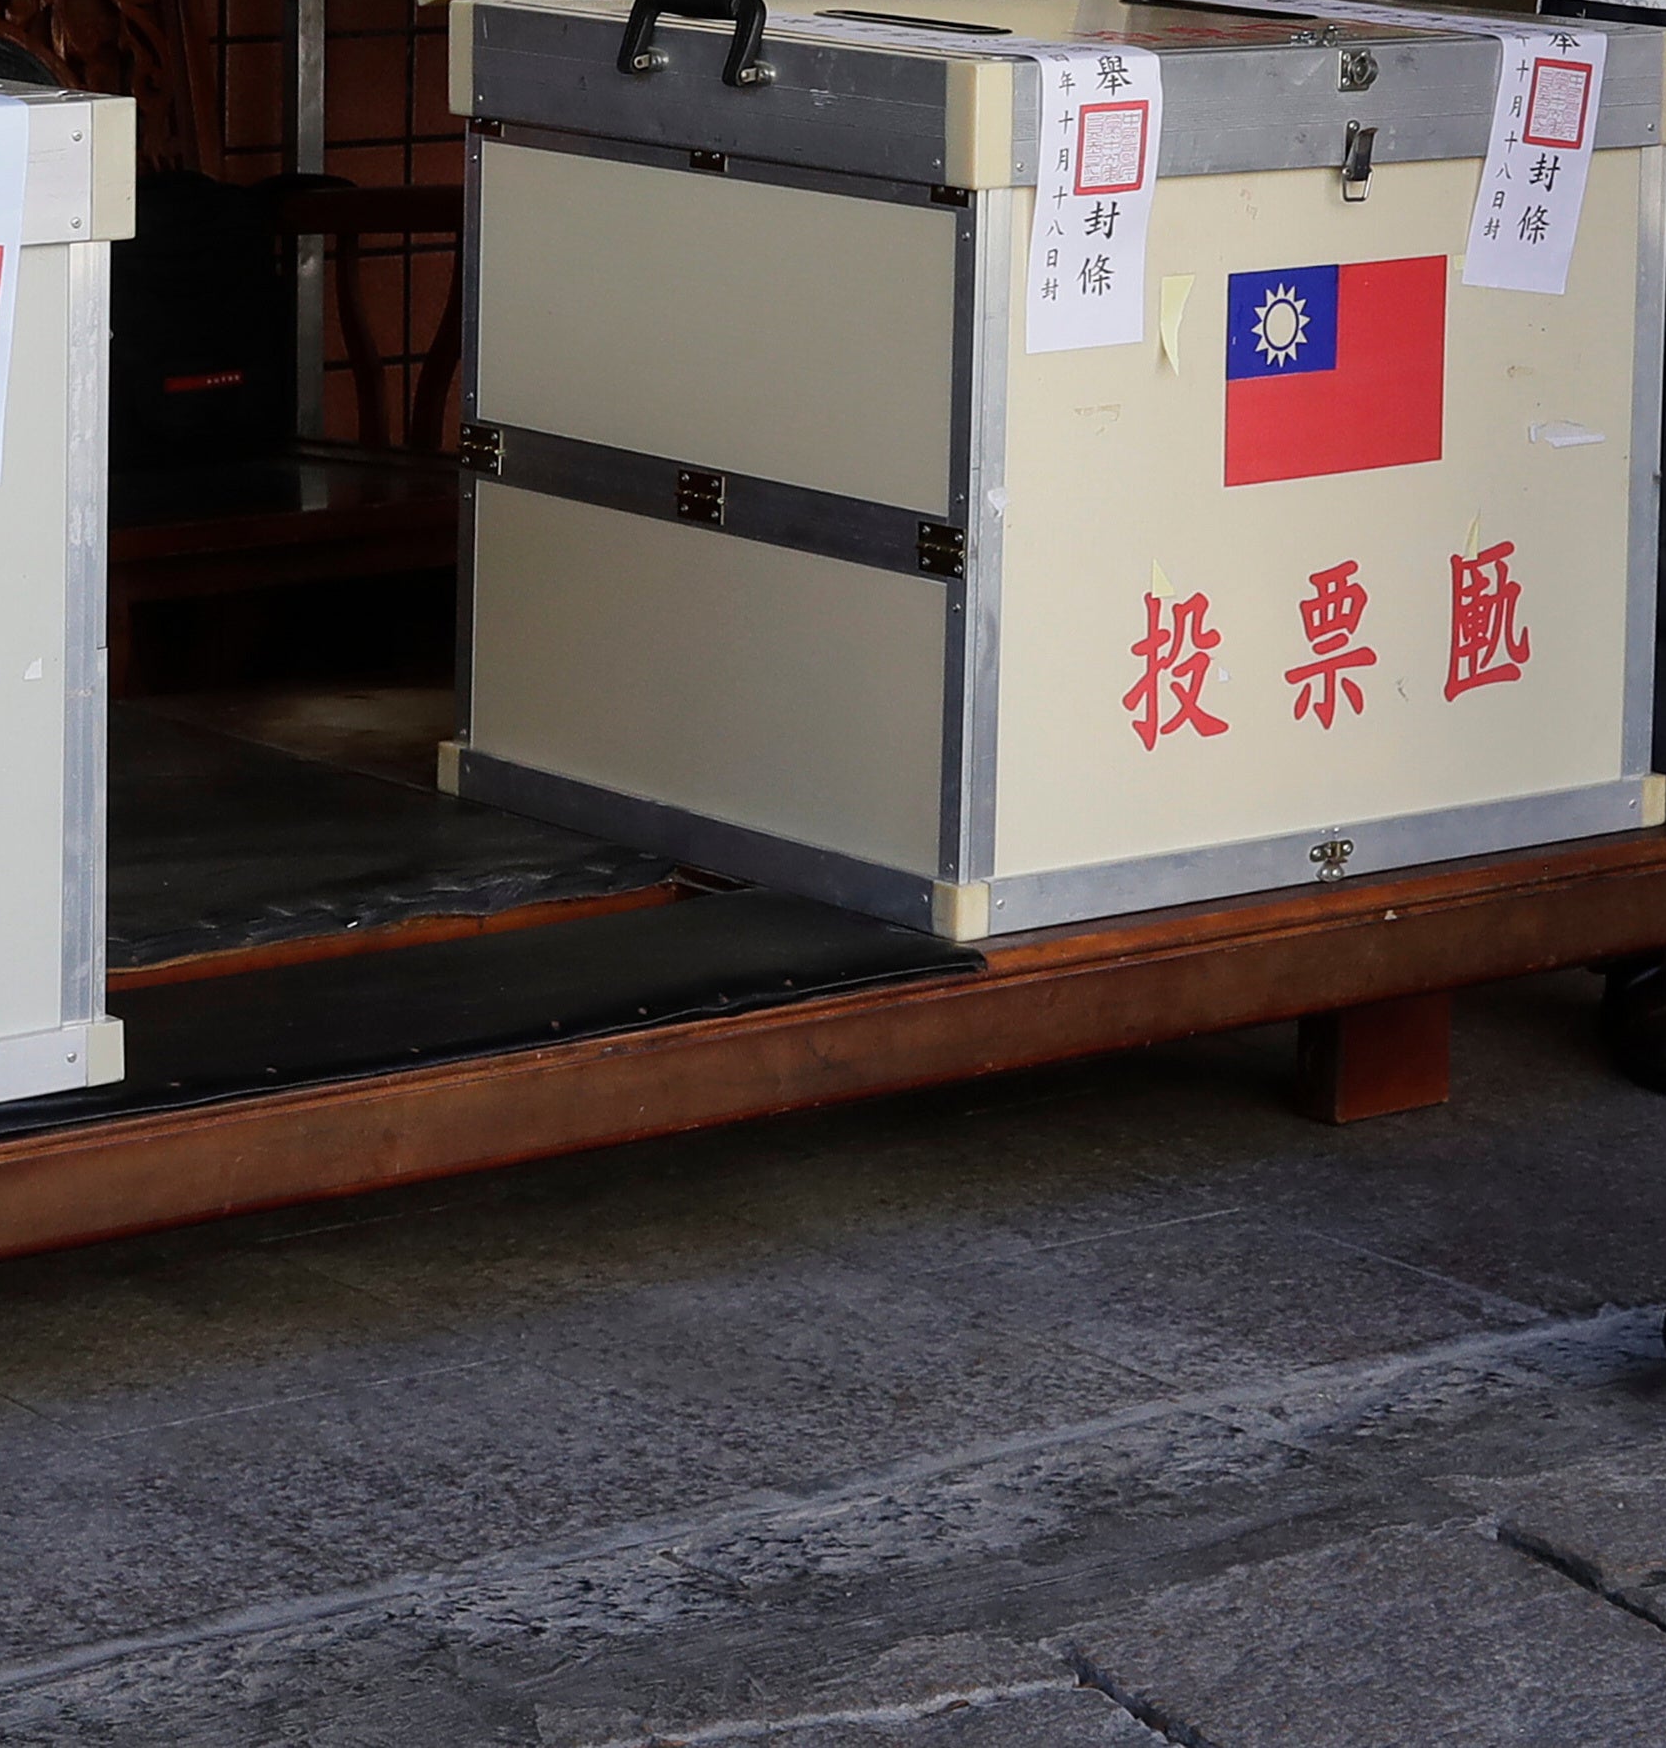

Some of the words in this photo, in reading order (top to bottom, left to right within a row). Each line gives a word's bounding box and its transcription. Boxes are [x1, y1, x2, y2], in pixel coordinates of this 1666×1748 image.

[1515, 151, 1563, 246] 封條
[1075, 199, 1122, 298] 封條
[1121, 540, 1532, 752] 投票匭
